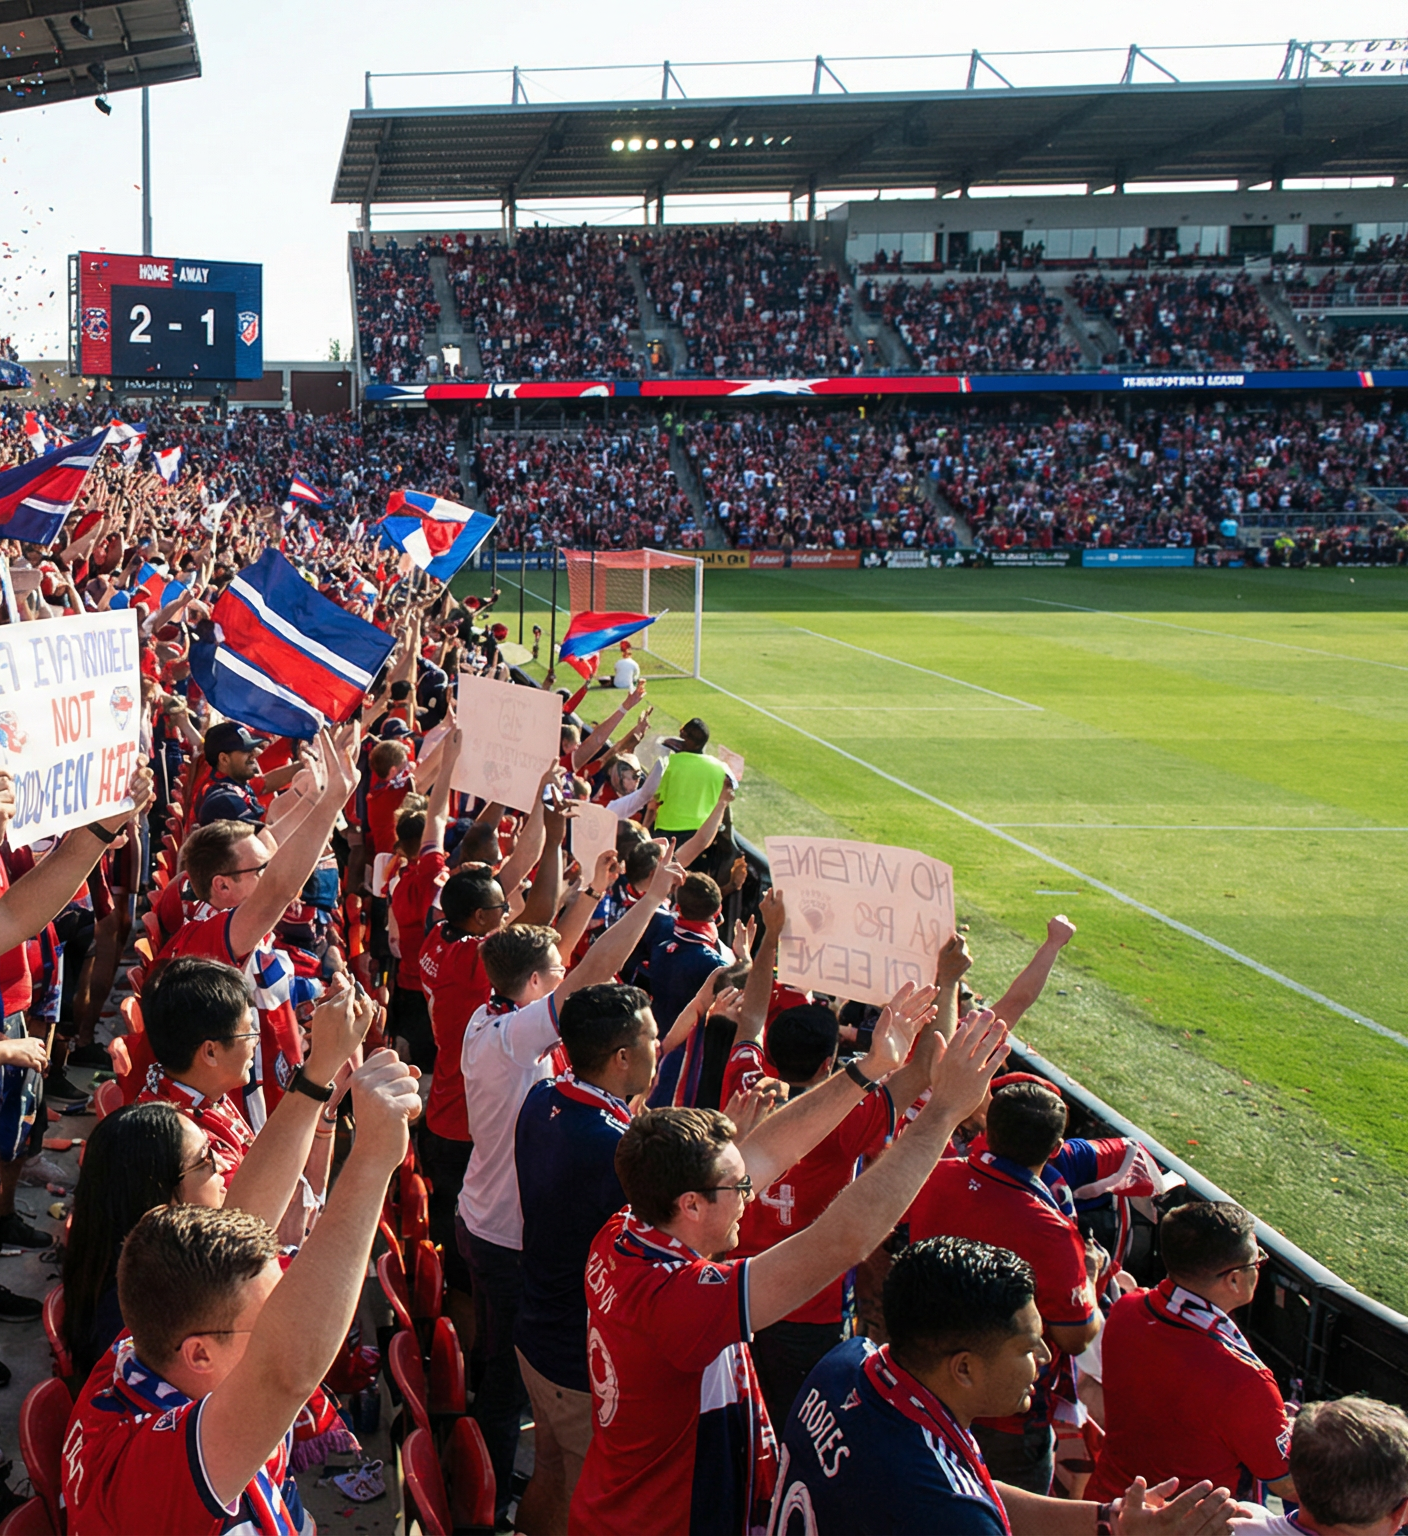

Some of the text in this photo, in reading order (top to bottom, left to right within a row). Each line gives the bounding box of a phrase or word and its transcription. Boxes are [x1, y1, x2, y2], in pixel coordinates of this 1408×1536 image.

[138, 263, 170, 282] HOME
[179, 267, 210, 284] AWAY
[129, 304, 152, 344] 2
[200, 308, 215, 346] 1
[51, 690, 95, 747] NOT
